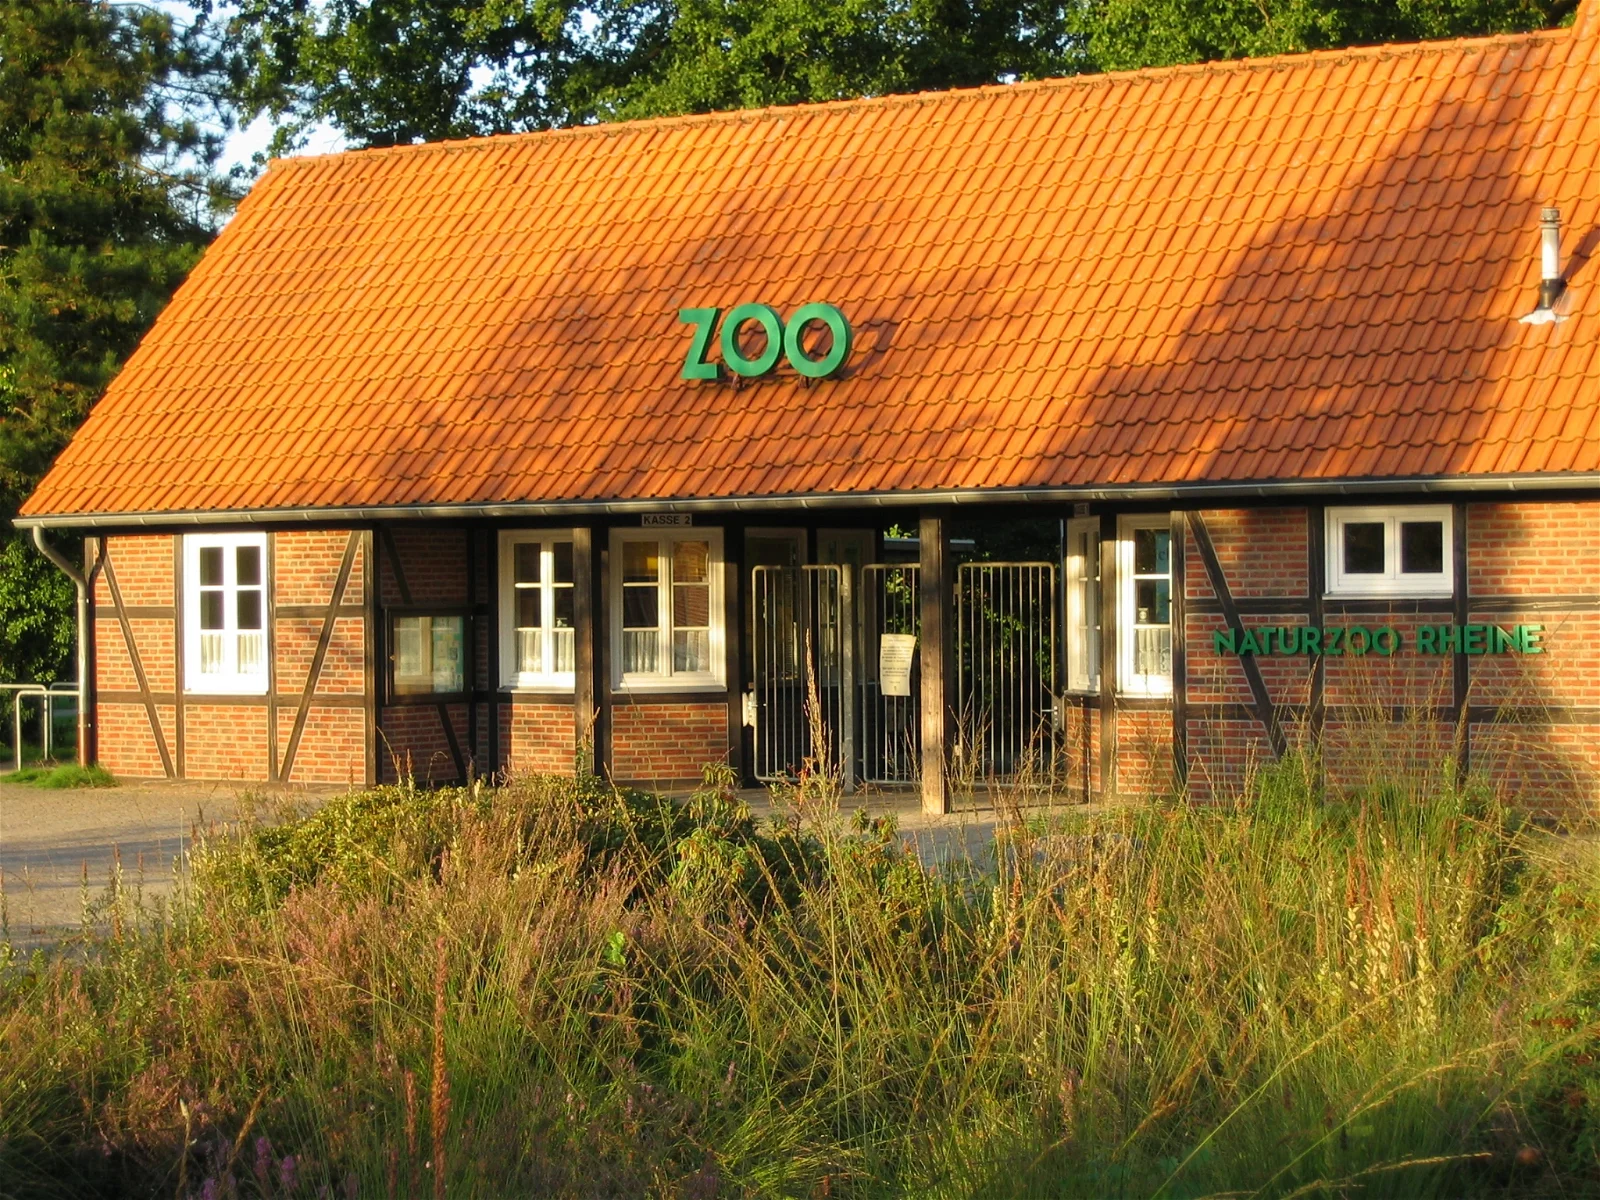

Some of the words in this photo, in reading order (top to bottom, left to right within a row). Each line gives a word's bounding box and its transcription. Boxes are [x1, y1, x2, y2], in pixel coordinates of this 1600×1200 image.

[678, 302, 850, 380] ZOO
[643, 515, 680, 525] KASSE
[684, 515, 691, 525] 2
[1213, 626, 1400, 656] NATURZOO
[1416, 624, 1545, 655] RHEINE
